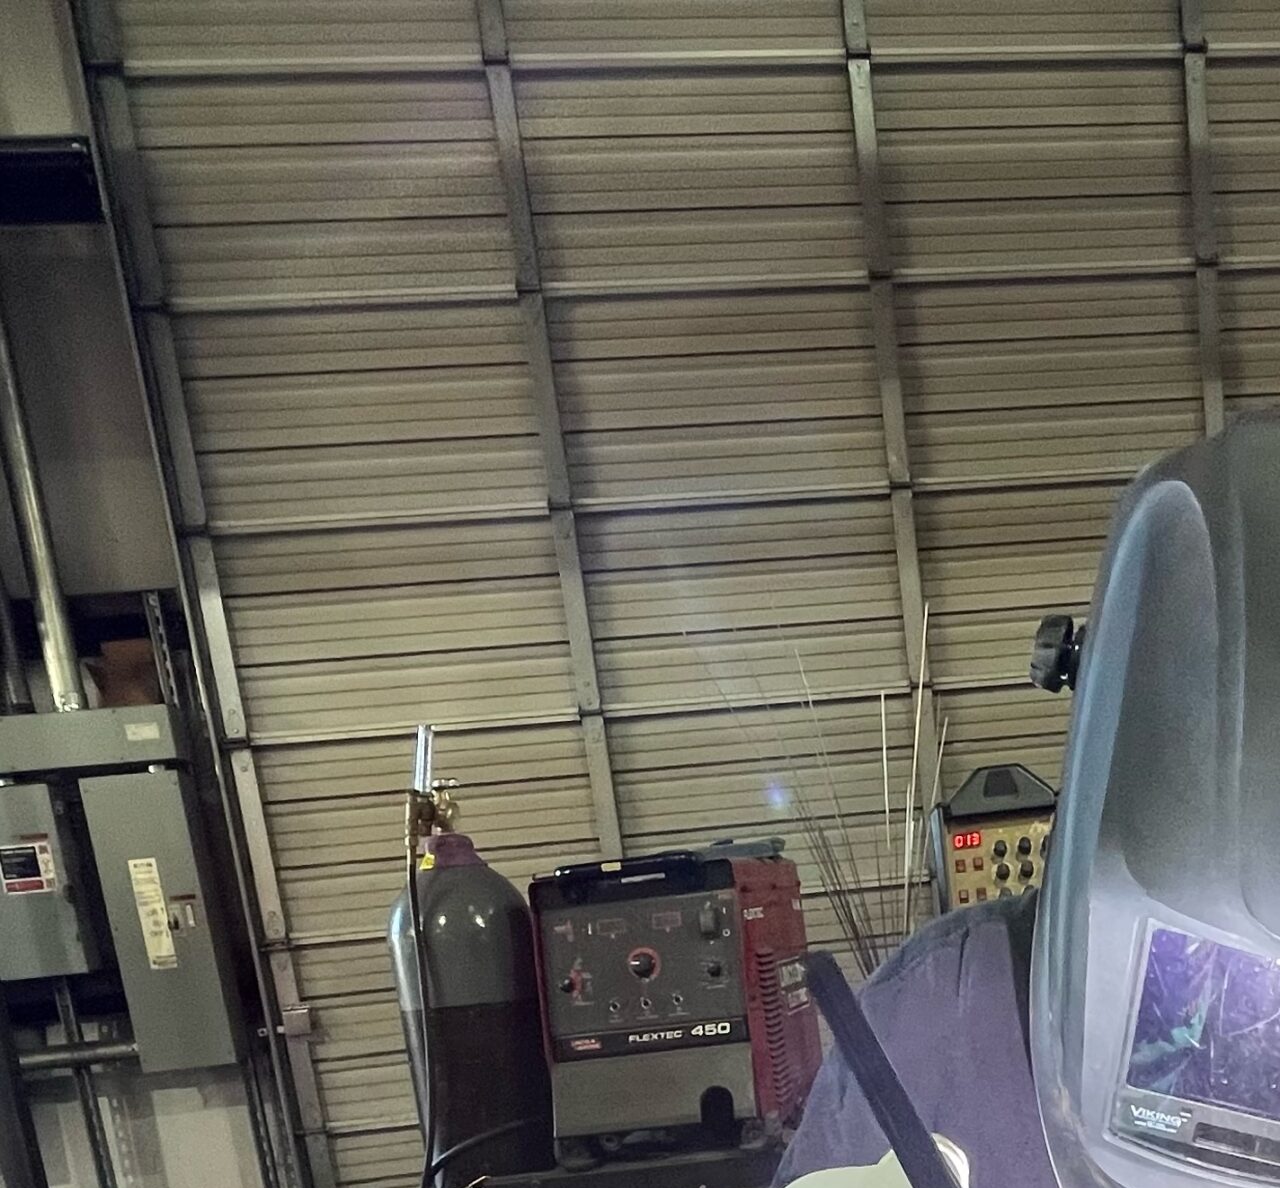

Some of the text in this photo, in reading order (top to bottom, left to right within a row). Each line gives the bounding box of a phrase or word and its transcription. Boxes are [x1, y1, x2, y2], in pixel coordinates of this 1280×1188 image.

[628, 1022, 731, 1044] FLEXTEC 450
[1130, 1104, 1182, 1128] VIKING
